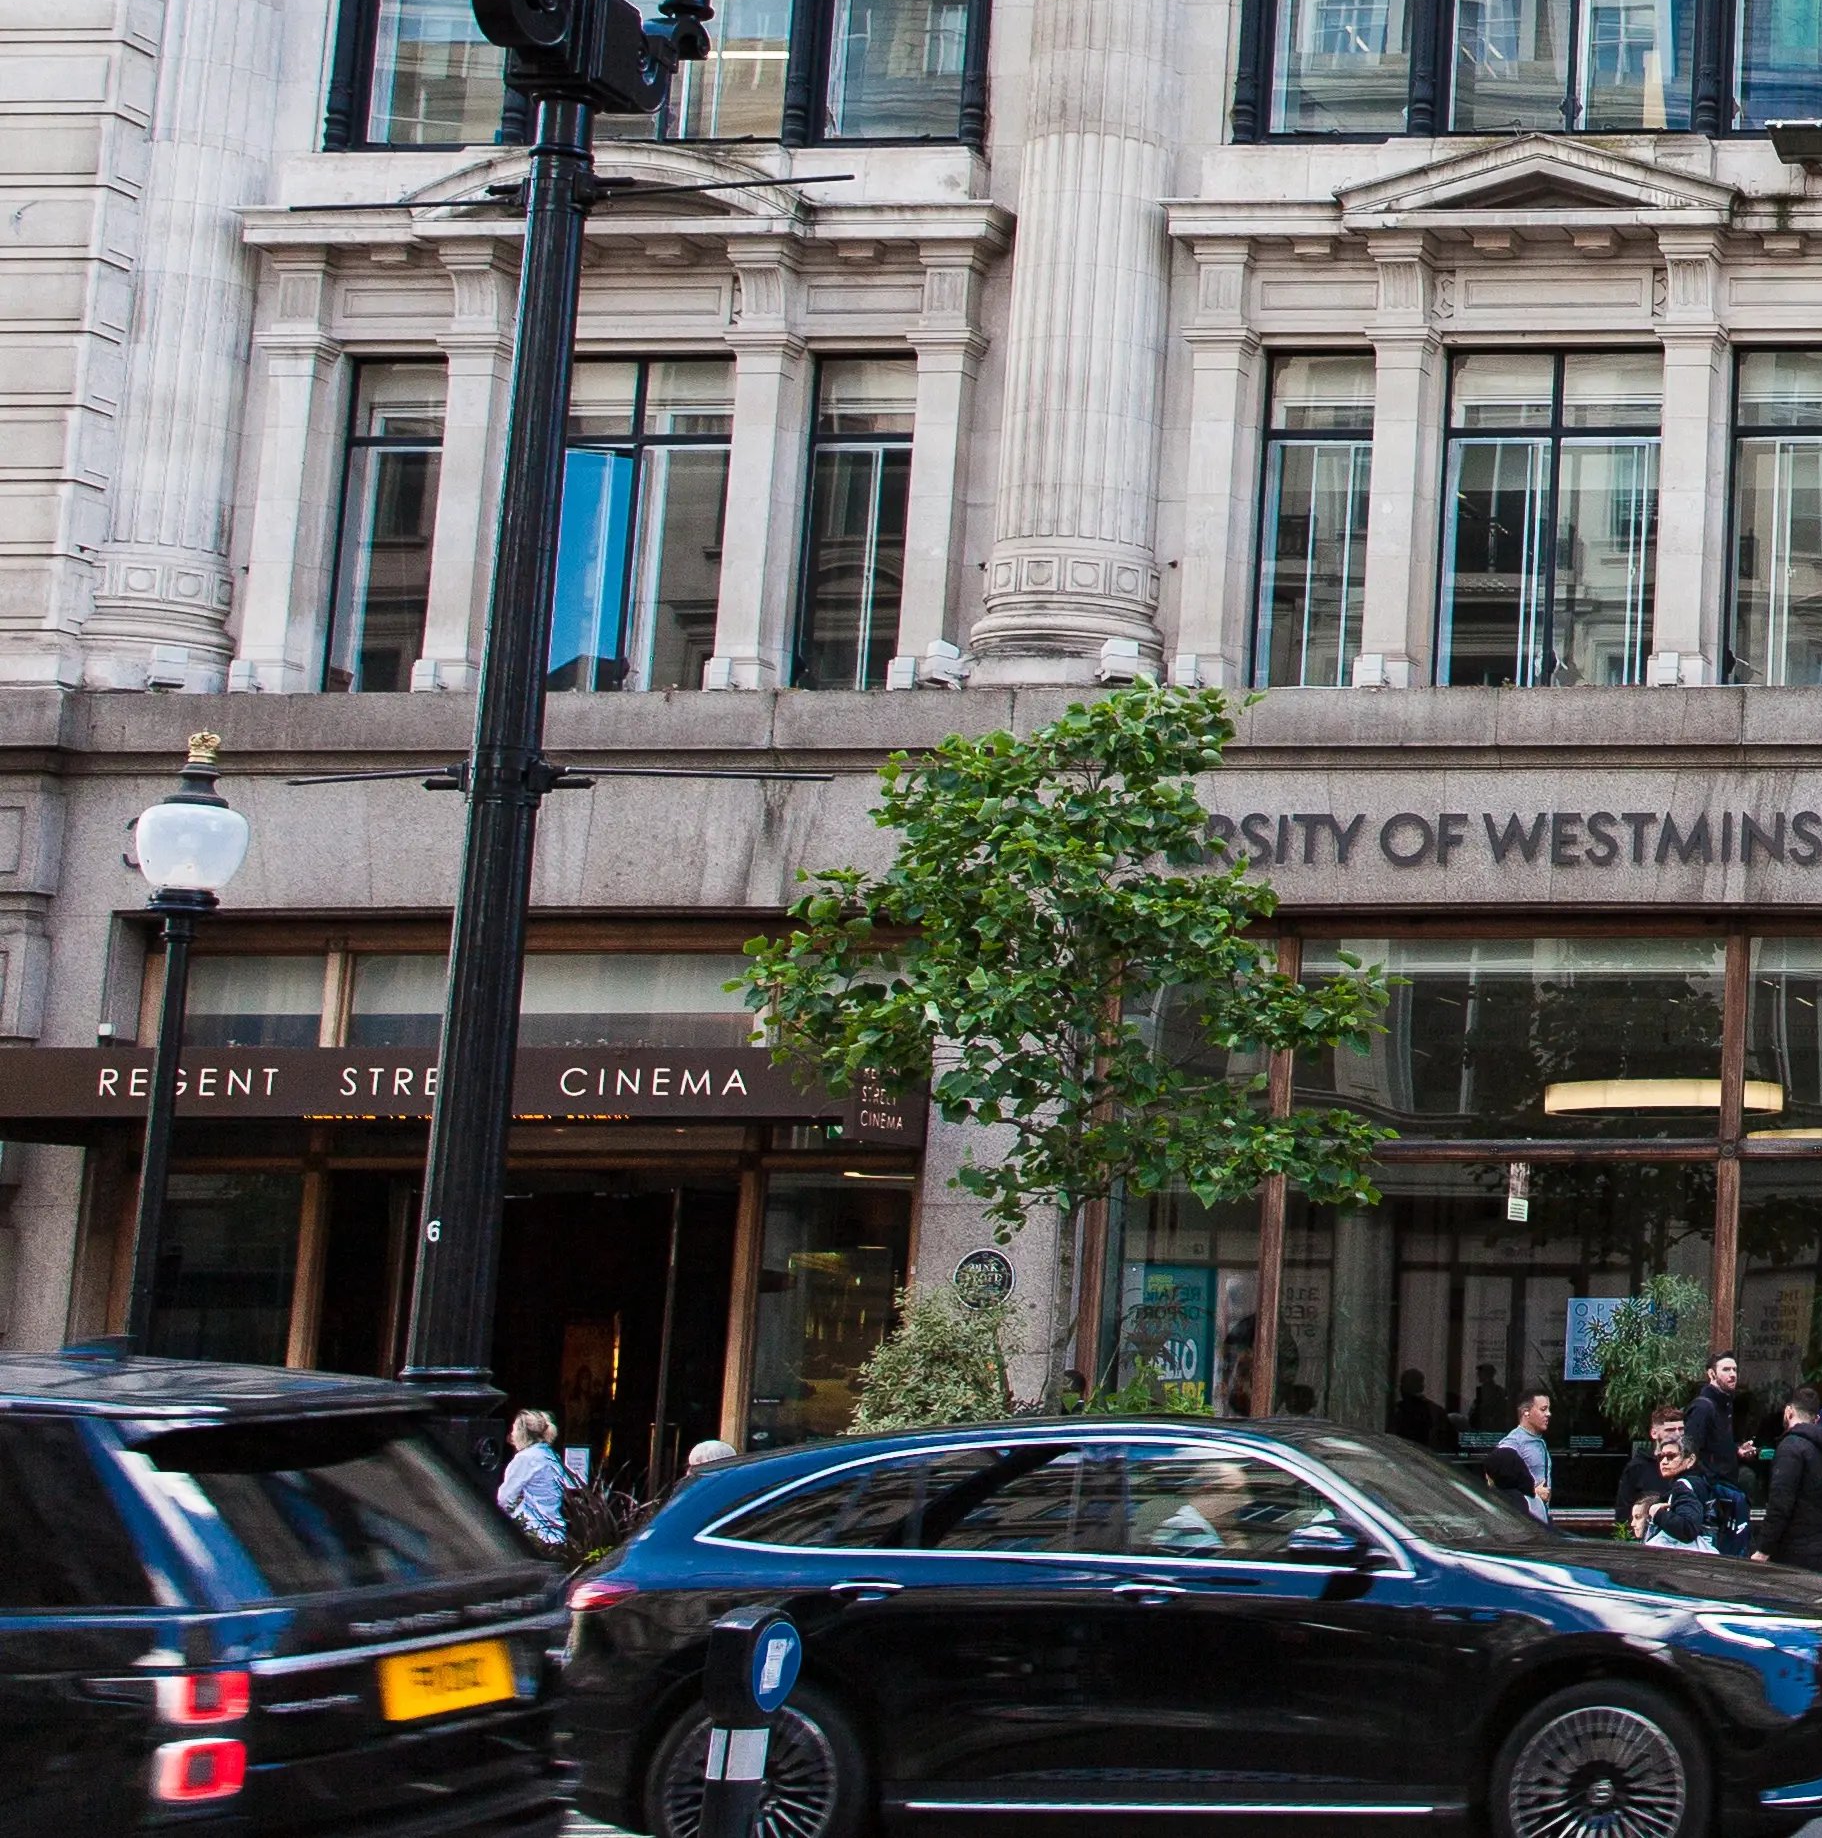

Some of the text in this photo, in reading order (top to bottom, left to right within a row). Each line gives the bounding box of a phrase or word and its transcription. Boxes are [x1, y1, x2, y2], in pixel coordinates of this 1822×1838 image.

[1202, 812, 1368, 866] RSITY
[1379, 811, 1470, 866] OF
[97, 1066, 749, 1097] REGENT STRE CINEMA
[860, 1109, 904, 1130] CINEMA
[427, 1220, 441, 1242] 6
